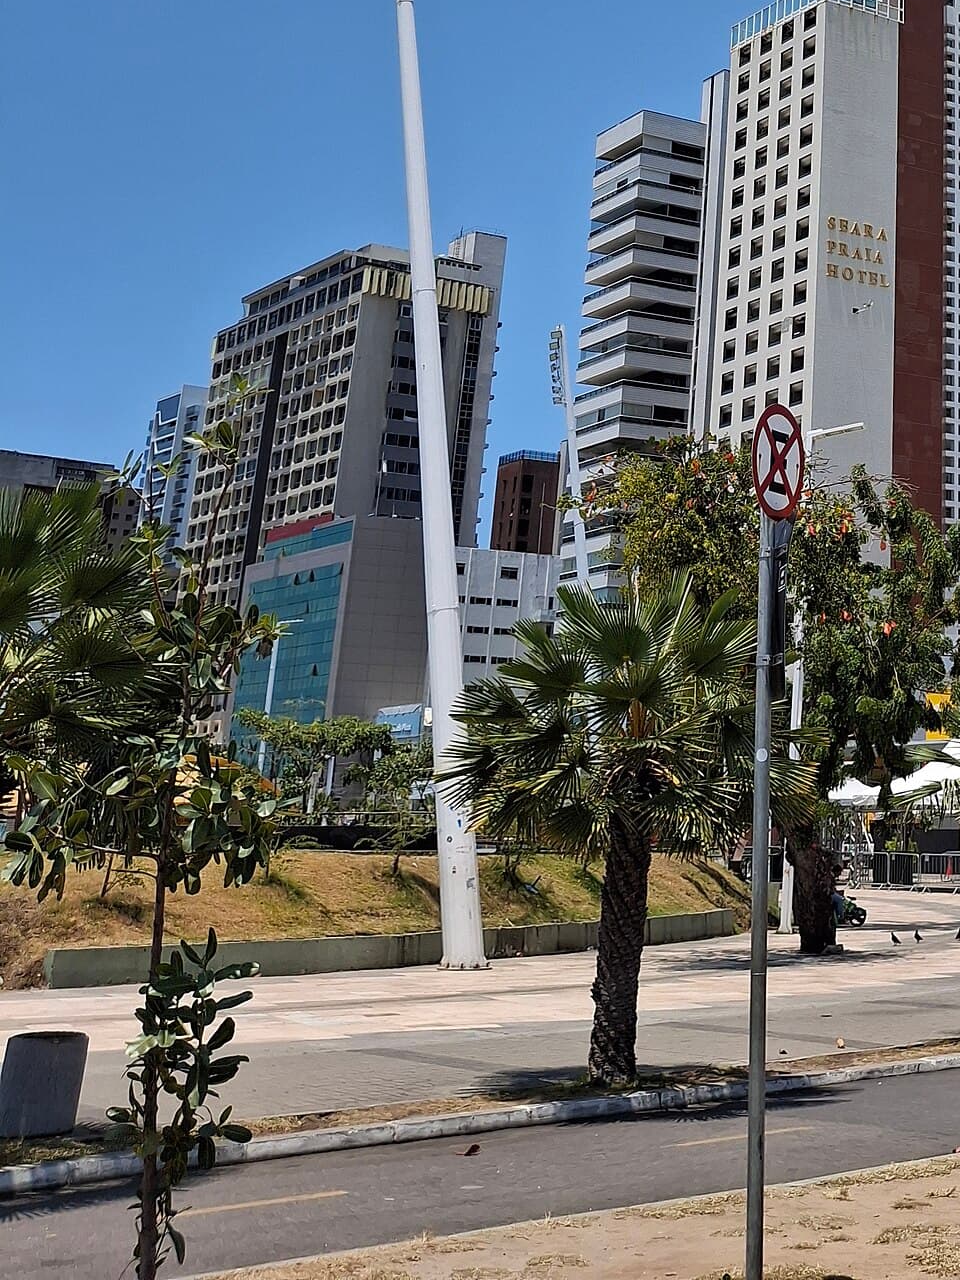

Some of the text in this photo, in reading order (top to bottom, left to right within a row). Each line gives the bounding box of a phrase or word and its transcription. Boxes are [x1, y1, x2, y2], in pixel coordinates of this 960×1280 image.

[827, 215, 888, 241] SEARA
[826, 239, 884, 265] PRAIA
[825, 263, 891, 288] HOTEL
